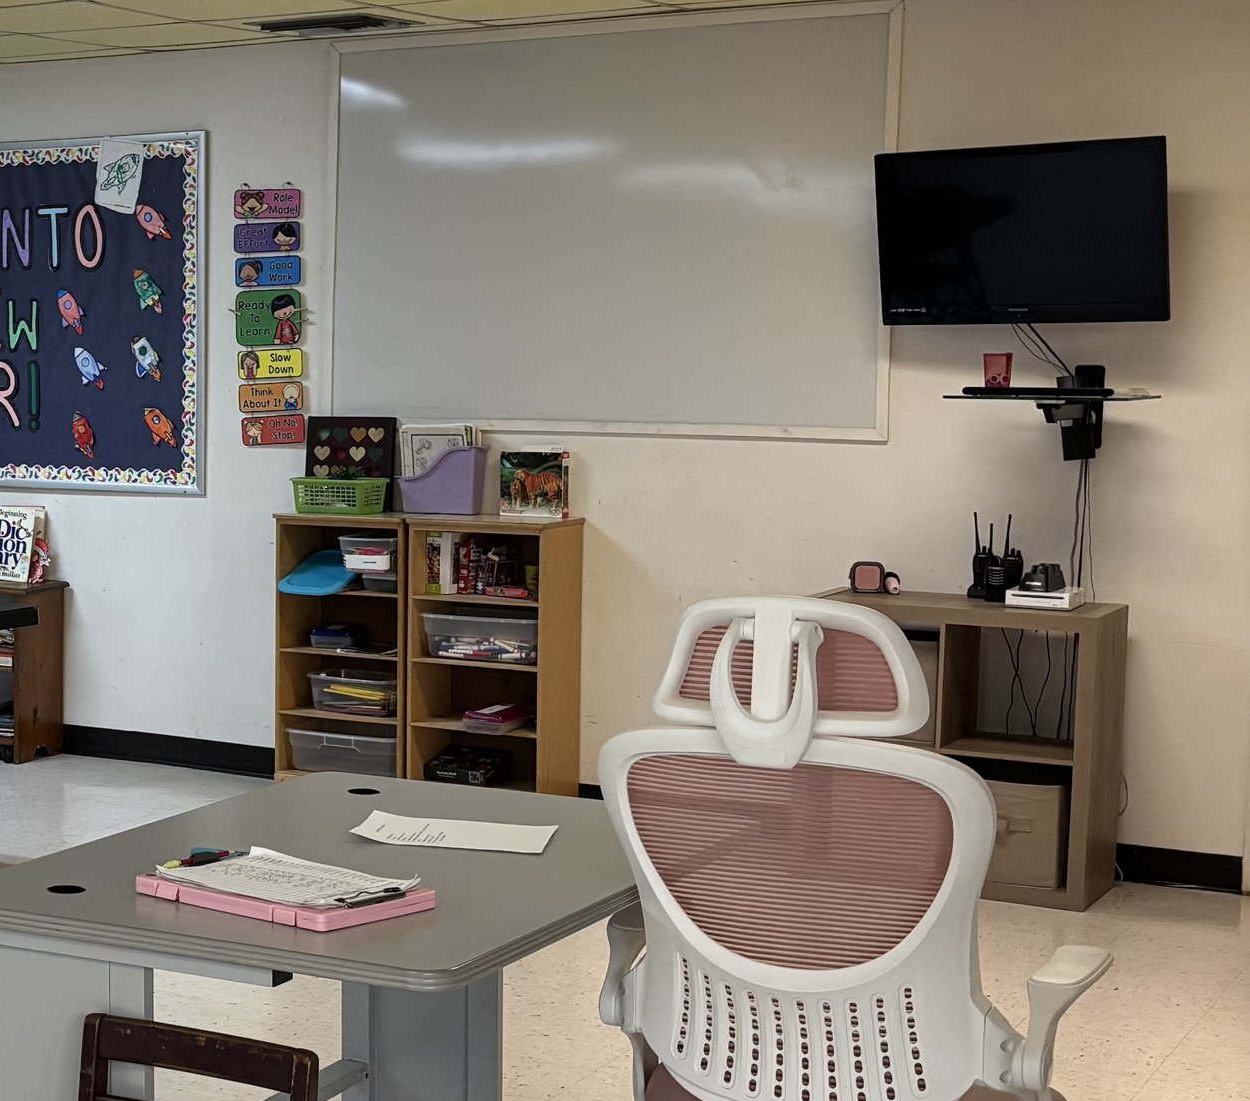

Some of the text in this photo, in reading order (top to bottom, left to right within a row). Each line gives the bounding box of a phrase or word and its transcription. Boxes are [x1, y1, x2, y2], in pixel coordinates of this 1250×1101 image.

[273, 193, 293, 202] Role
[268, 205, 298, 214] Model
[240, 228, 267, 237] Great
[238, 240, 268, 249] Effort
[269, 261, 293, 270] Good
[269, 273, 293, 282] Work
[238, 301, 270, 311] Ready
[250, 313, 260, 323] To
[240, 327, 270, 336] Learn
[270, 353, 291, 362] Slow
[268, 365, 294, 374] Down
[250, 387, 273, 397] Think
[243, 398, 281, 408] About It
[269, 419, 280, 428] Oh
